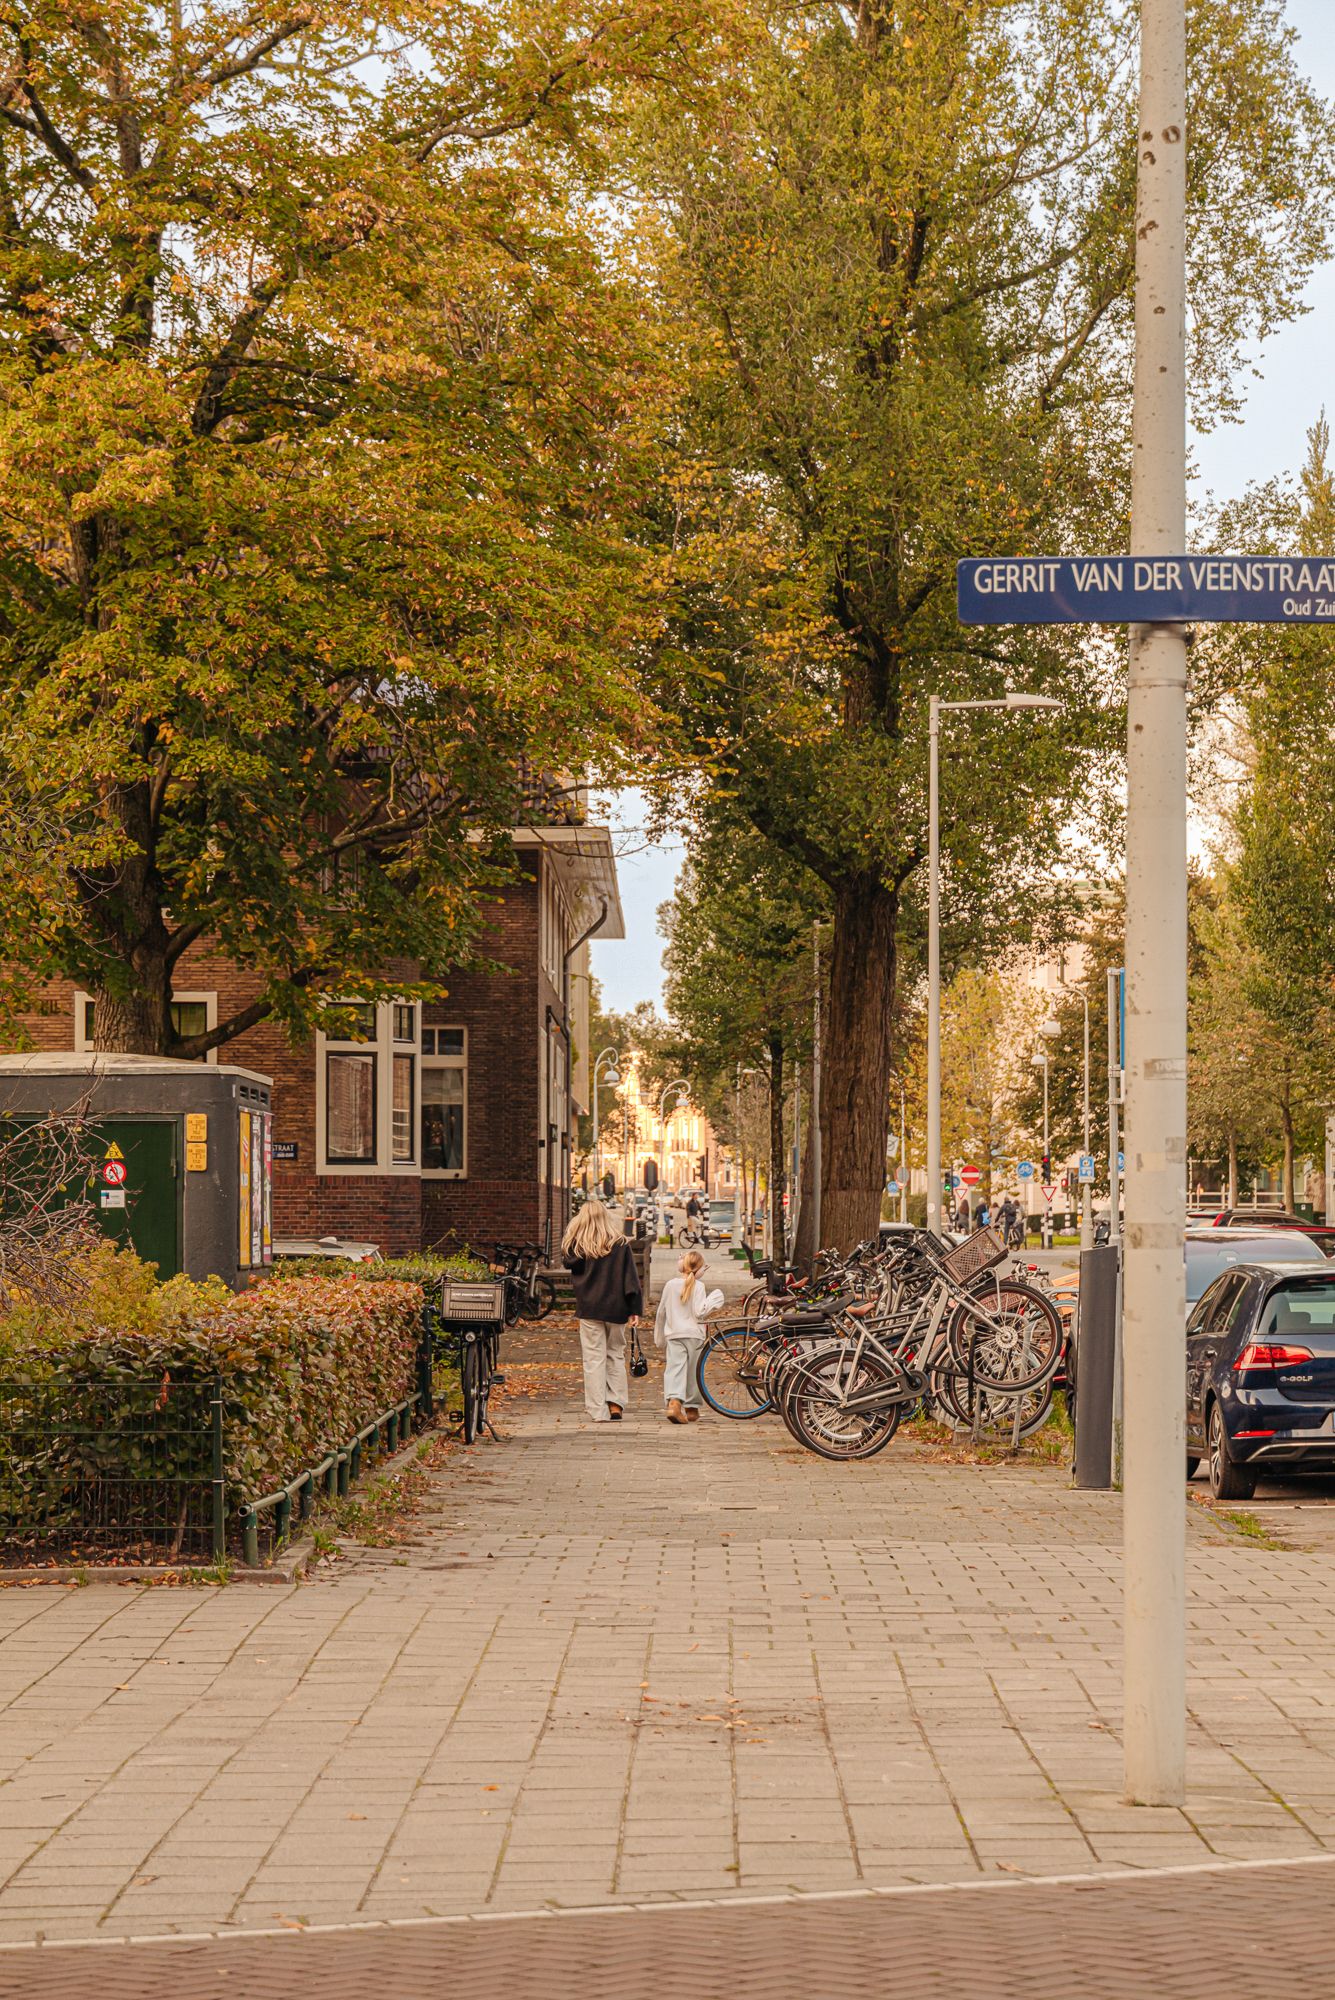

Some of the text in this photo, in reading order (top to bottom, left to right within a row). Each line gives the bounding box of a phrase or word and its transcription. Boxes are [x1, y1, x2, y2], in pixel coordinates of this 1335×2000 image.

[974, 563, 1061, 593] GERRIT
[1071, 562, 1123, 592] VAN
[1134, 561, 1183, 591] DER
[1282, 598, 1312, 616] Oud
